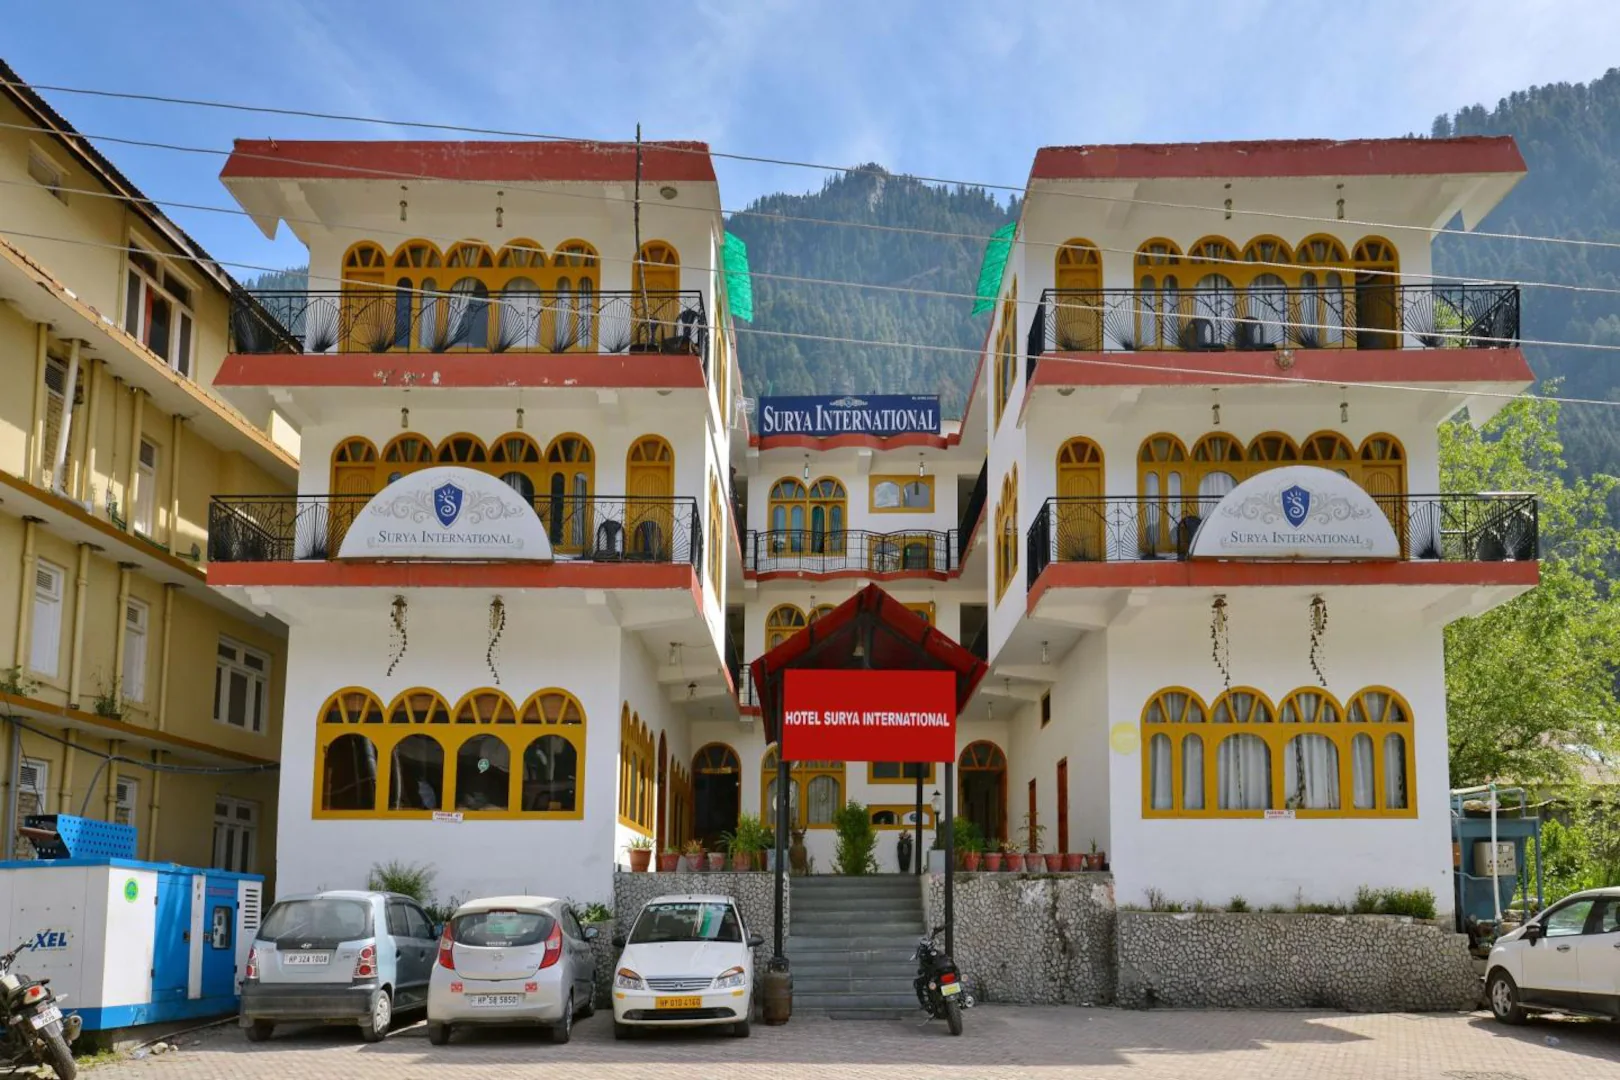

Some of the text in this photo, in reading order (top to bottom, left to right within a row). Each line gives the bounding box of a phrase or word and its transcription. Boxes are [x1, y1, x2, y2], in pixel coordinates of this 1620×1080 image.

[764, 404, 937, 432] SURYA INTERNATIONAL
[378, 530, 514, 545] SURYA INTERNATIONAL
[1230, 530, 1363, 545] SURYA INTERNATIONAL
[785, 711, 950, 727] HOTEL SURYA INTERNATIONAL
